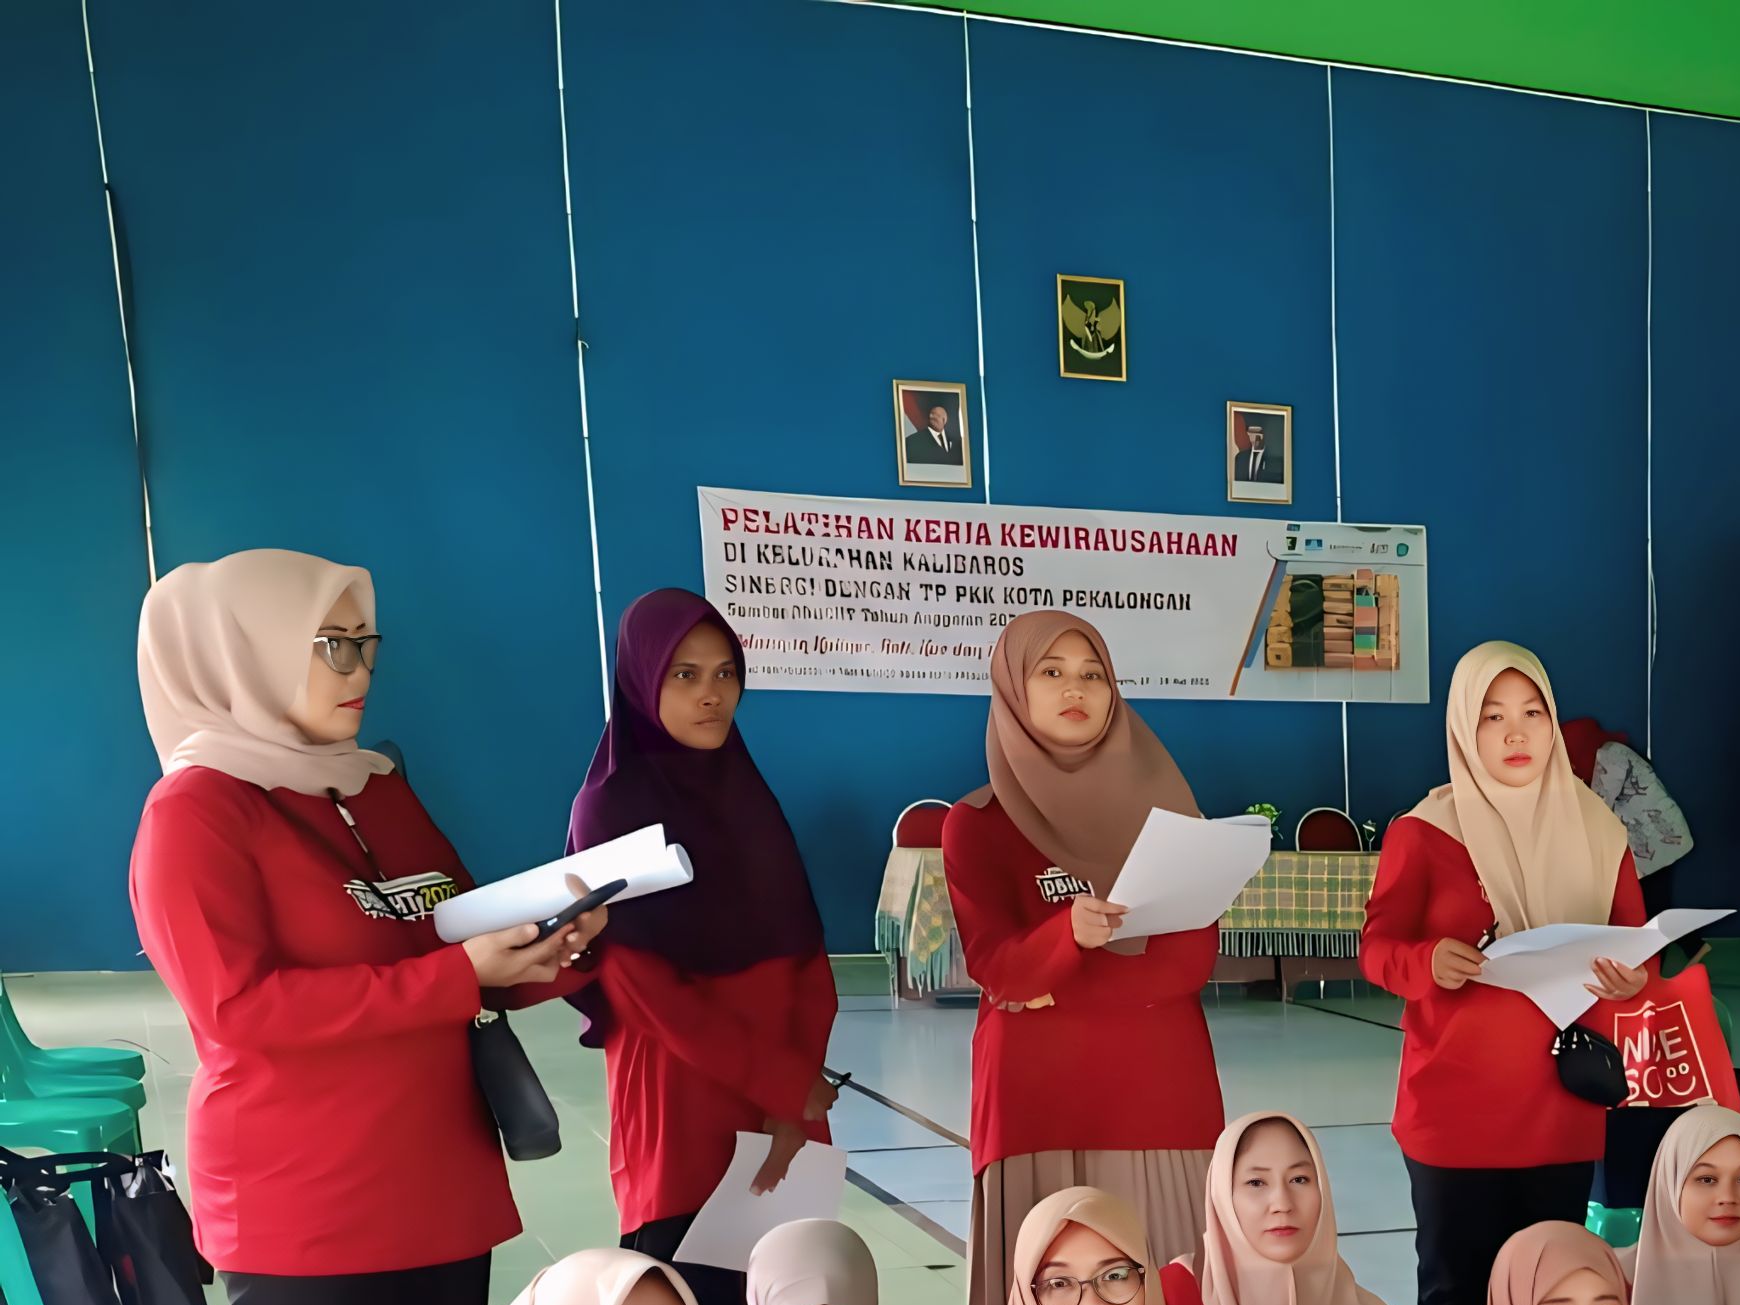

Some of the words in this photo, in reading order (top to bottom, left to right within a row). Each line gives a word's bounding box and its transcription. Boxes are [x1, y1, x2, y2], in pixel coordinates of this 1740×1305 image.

[721, 508, 894, 540] PELATIHAN
[904, 518, 991, 546] KERJA
[1000, 523, 1238, 557] KEWIRAUSAHAAN
[724, 542, 746, 563] DI
[903, 552, 1024, 577] KALIBAROS
[920, 584, 947, 602] TP
[956, 585, 994, 604] PKK
[1003, 587, 1054, 607] KOTA
[1063, 589, 1192, 611] PEKALONGAN
